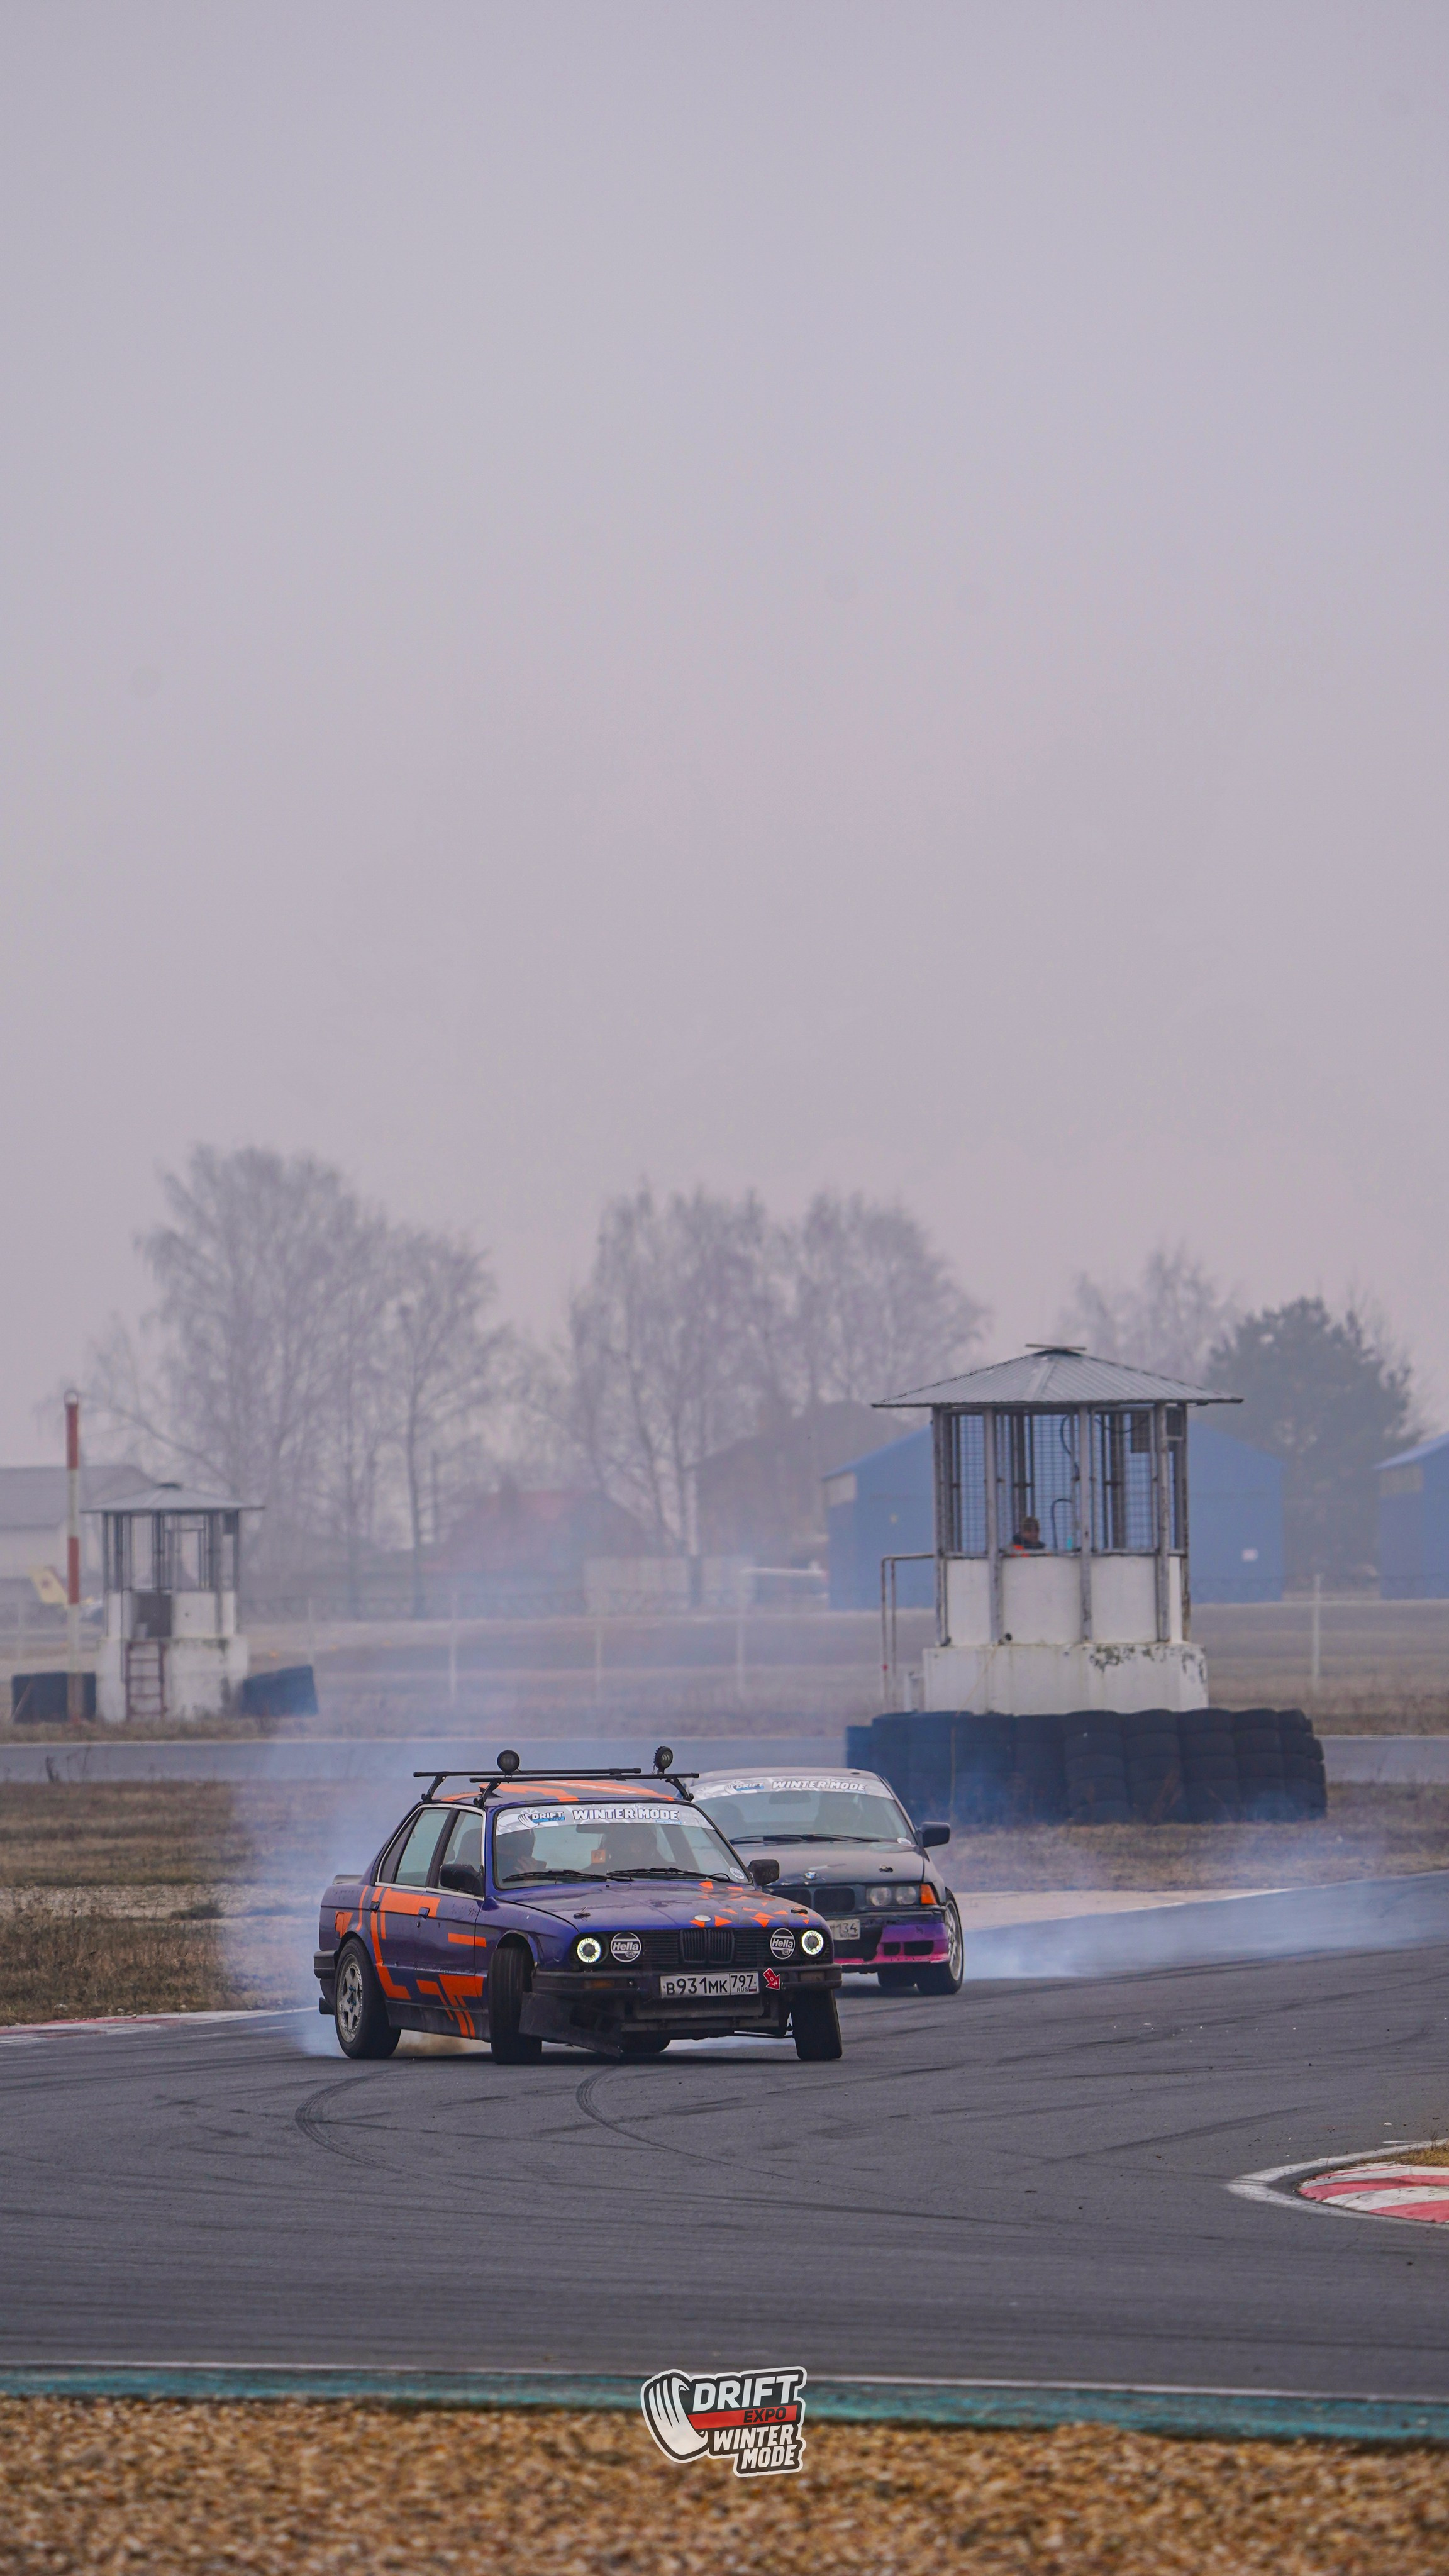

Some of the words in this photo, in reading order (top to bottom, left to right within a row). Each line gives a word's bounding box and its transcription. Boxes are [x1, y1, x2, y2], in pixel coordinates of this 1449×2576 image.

[772, 1780, 827, 1789] WINTER
[829, 1781, 867, 1791] MODE
[531, 1811, 564, 1820] DRIFT
[572, 1808, 636, 1820] WINTER
[637, 1809, 680, 1821] MODE
[613, 1941, 639, 1950] Hella
[772, 1938, 794, 1948] Hella
[731, 1974, 754, 1988] 797
[767, 1972, 779, 1987] TOW
